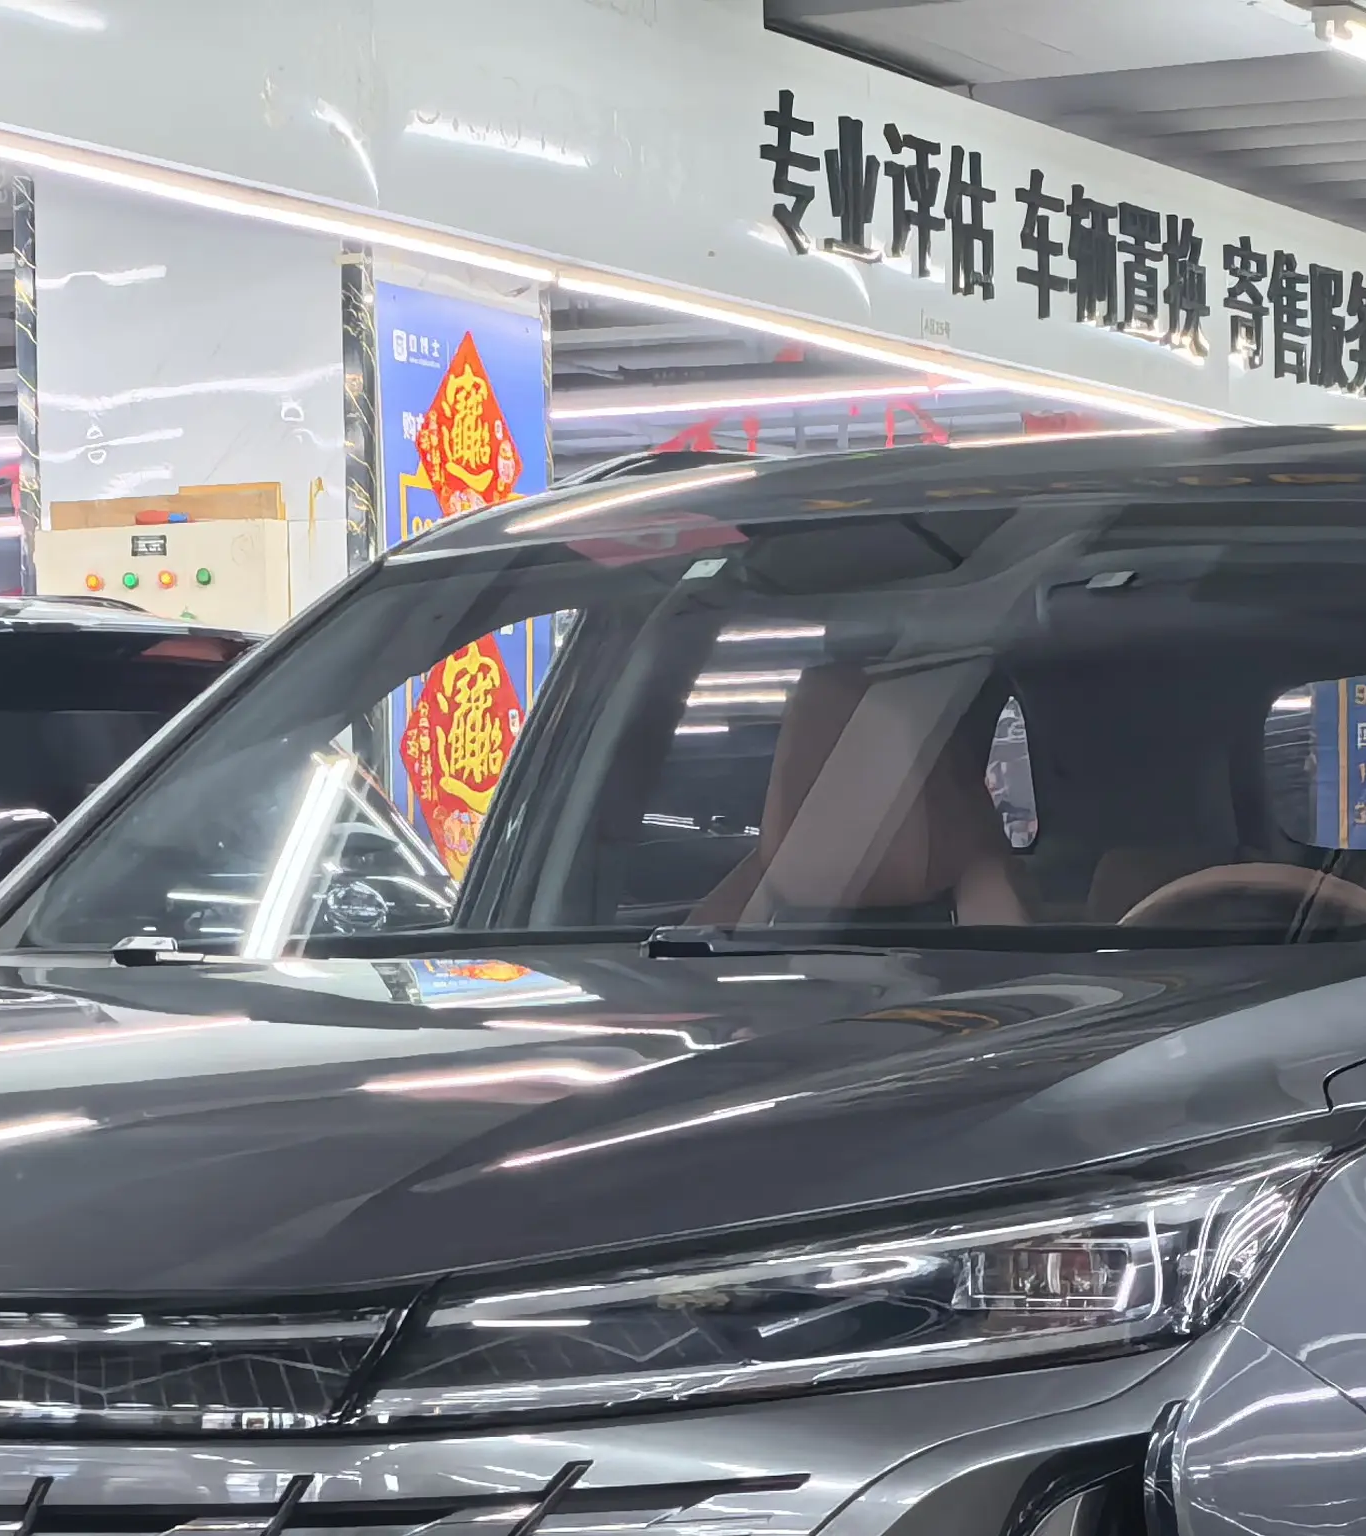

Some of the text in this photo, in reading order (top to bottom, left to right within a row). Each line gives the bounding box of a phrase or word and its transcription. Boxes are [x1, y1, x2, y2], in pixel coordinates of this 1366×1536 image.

[760, 89, 997, 301] 专业评估
[1015, 169, 1210, 366] 车辆置换
